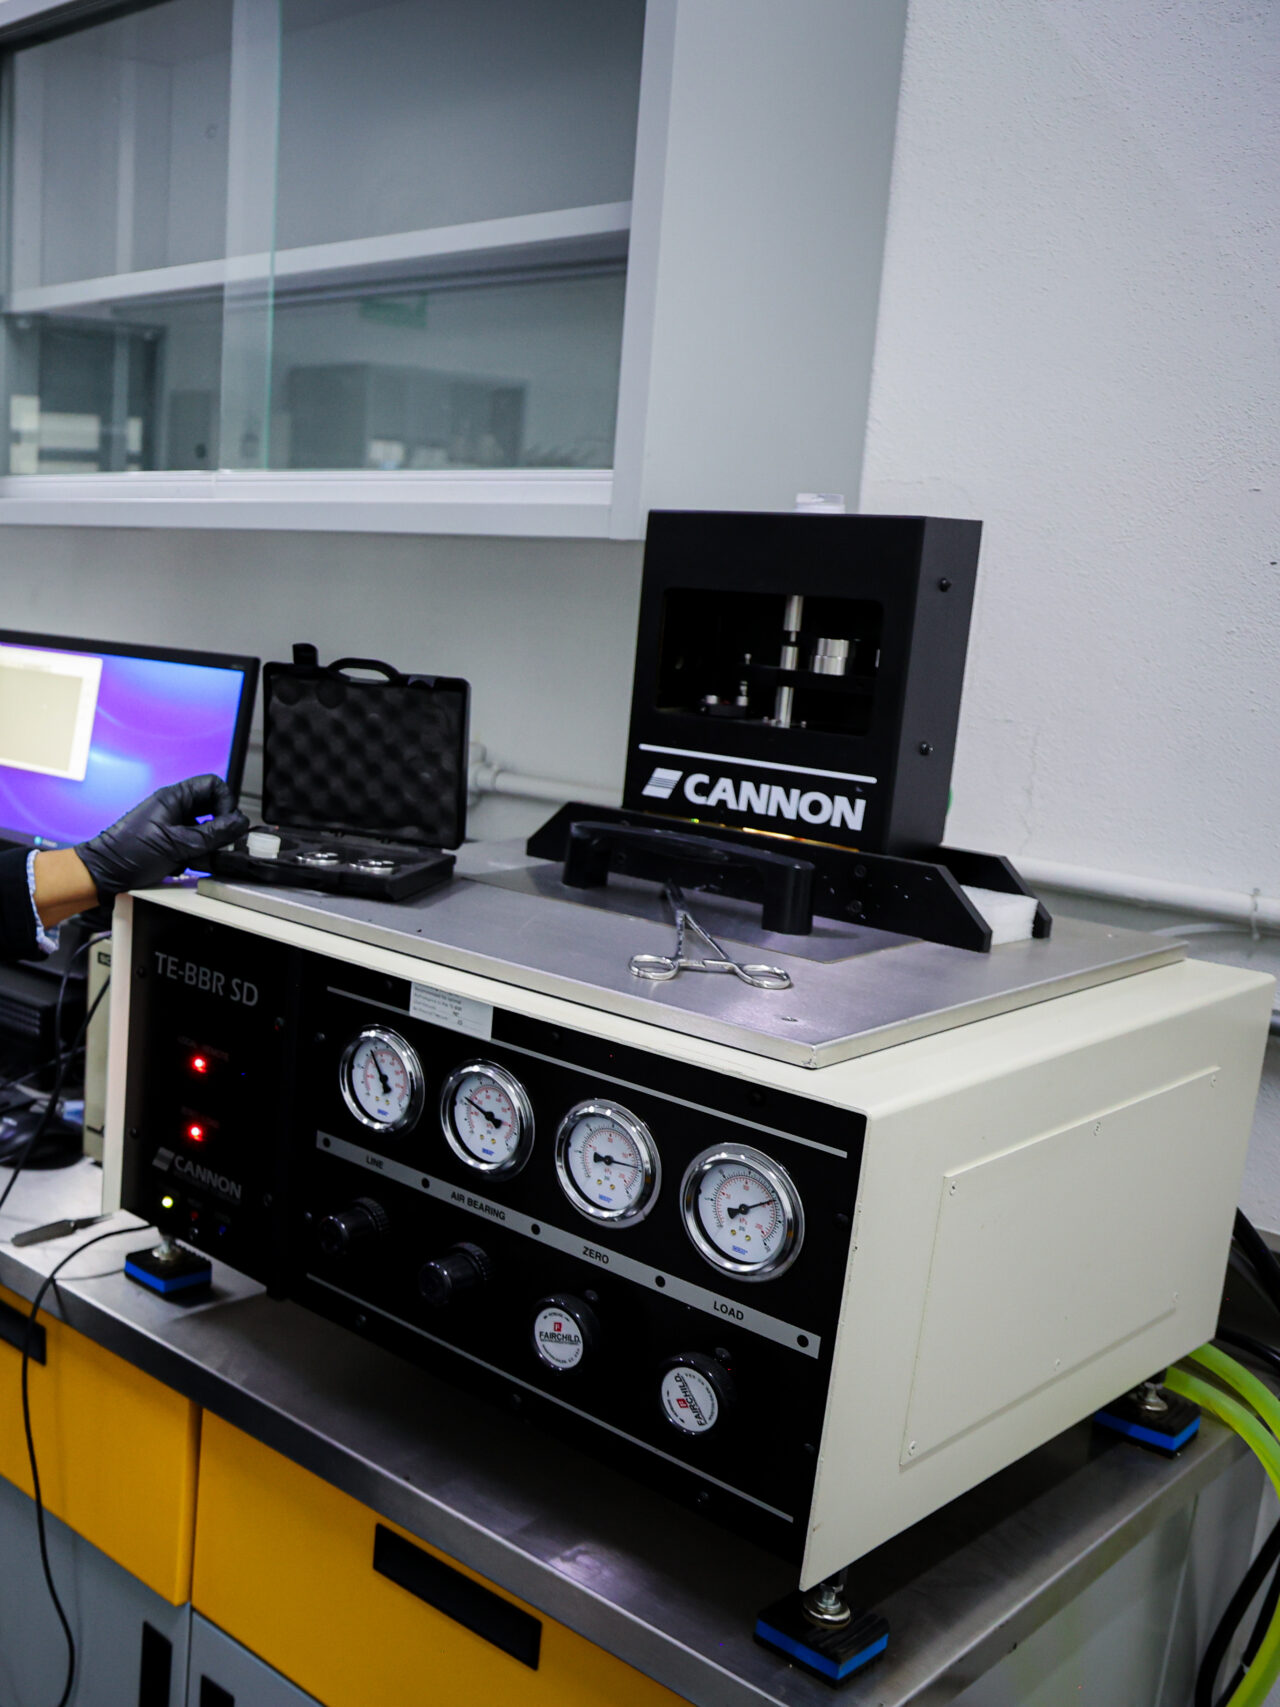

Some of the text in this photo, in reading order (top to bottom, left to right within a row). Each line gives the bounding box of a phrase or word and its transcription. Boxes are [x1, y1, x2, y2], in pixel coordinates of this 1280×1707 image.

[683, 773, 867, 831] CANNON
[154, 951, 259, 1007] TE-BBR SD
[173, 1154, 242, 1199] CANNON
[366, 1155, 384, 1170] LINE
[451, 1191, 506, 1221] AIR BEARING
[582, 1245, 610, 1265] ZERO
[712, 1300, 746, 1322] LOAD
[539, 1331, 581, 1343] FAIRCHILD
[674, 1375, 706, 1426] FAIRCHILD
